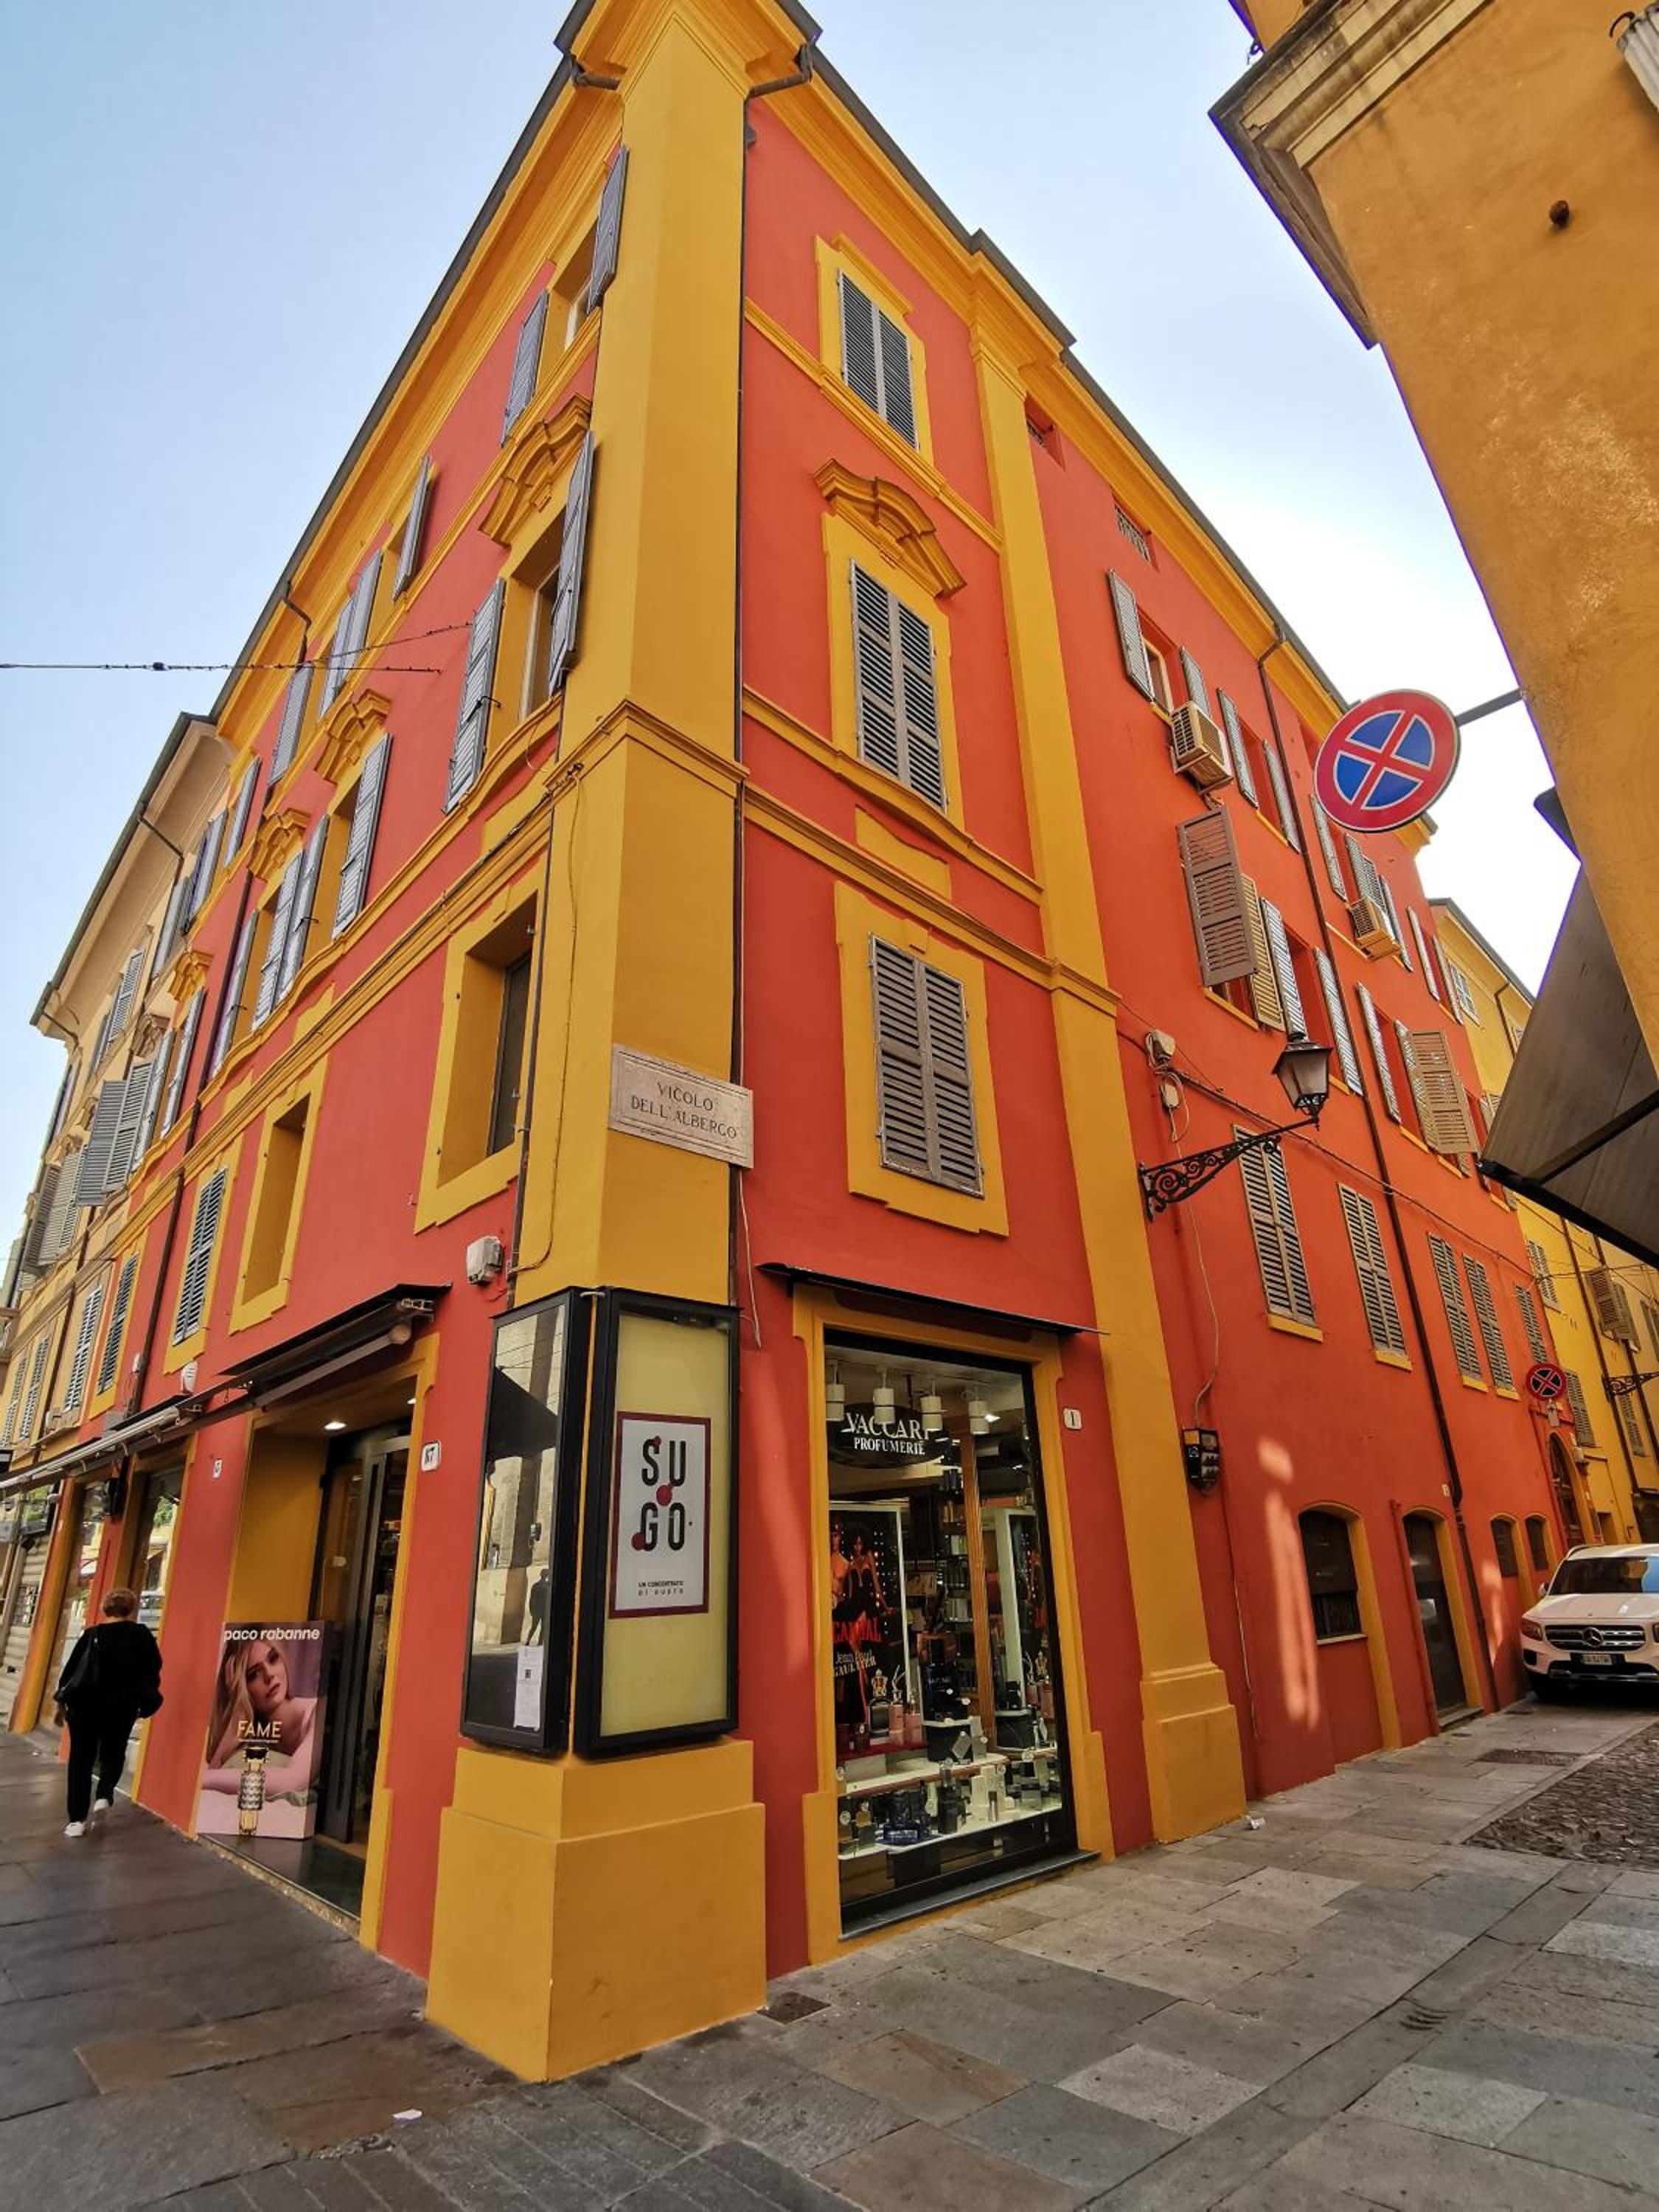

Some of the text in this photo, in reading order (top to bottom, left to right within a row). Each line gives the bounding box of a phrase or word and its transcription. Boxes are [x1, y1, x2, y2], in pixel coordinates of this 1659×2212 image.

[657, 1081, 714, 1111] VICOLO
[853, 1436, 926, 1455] PROFUMERIE
[223, 1627, 320, 1642] paco rabanne
[237, 1719, 282, 1738] FAME
